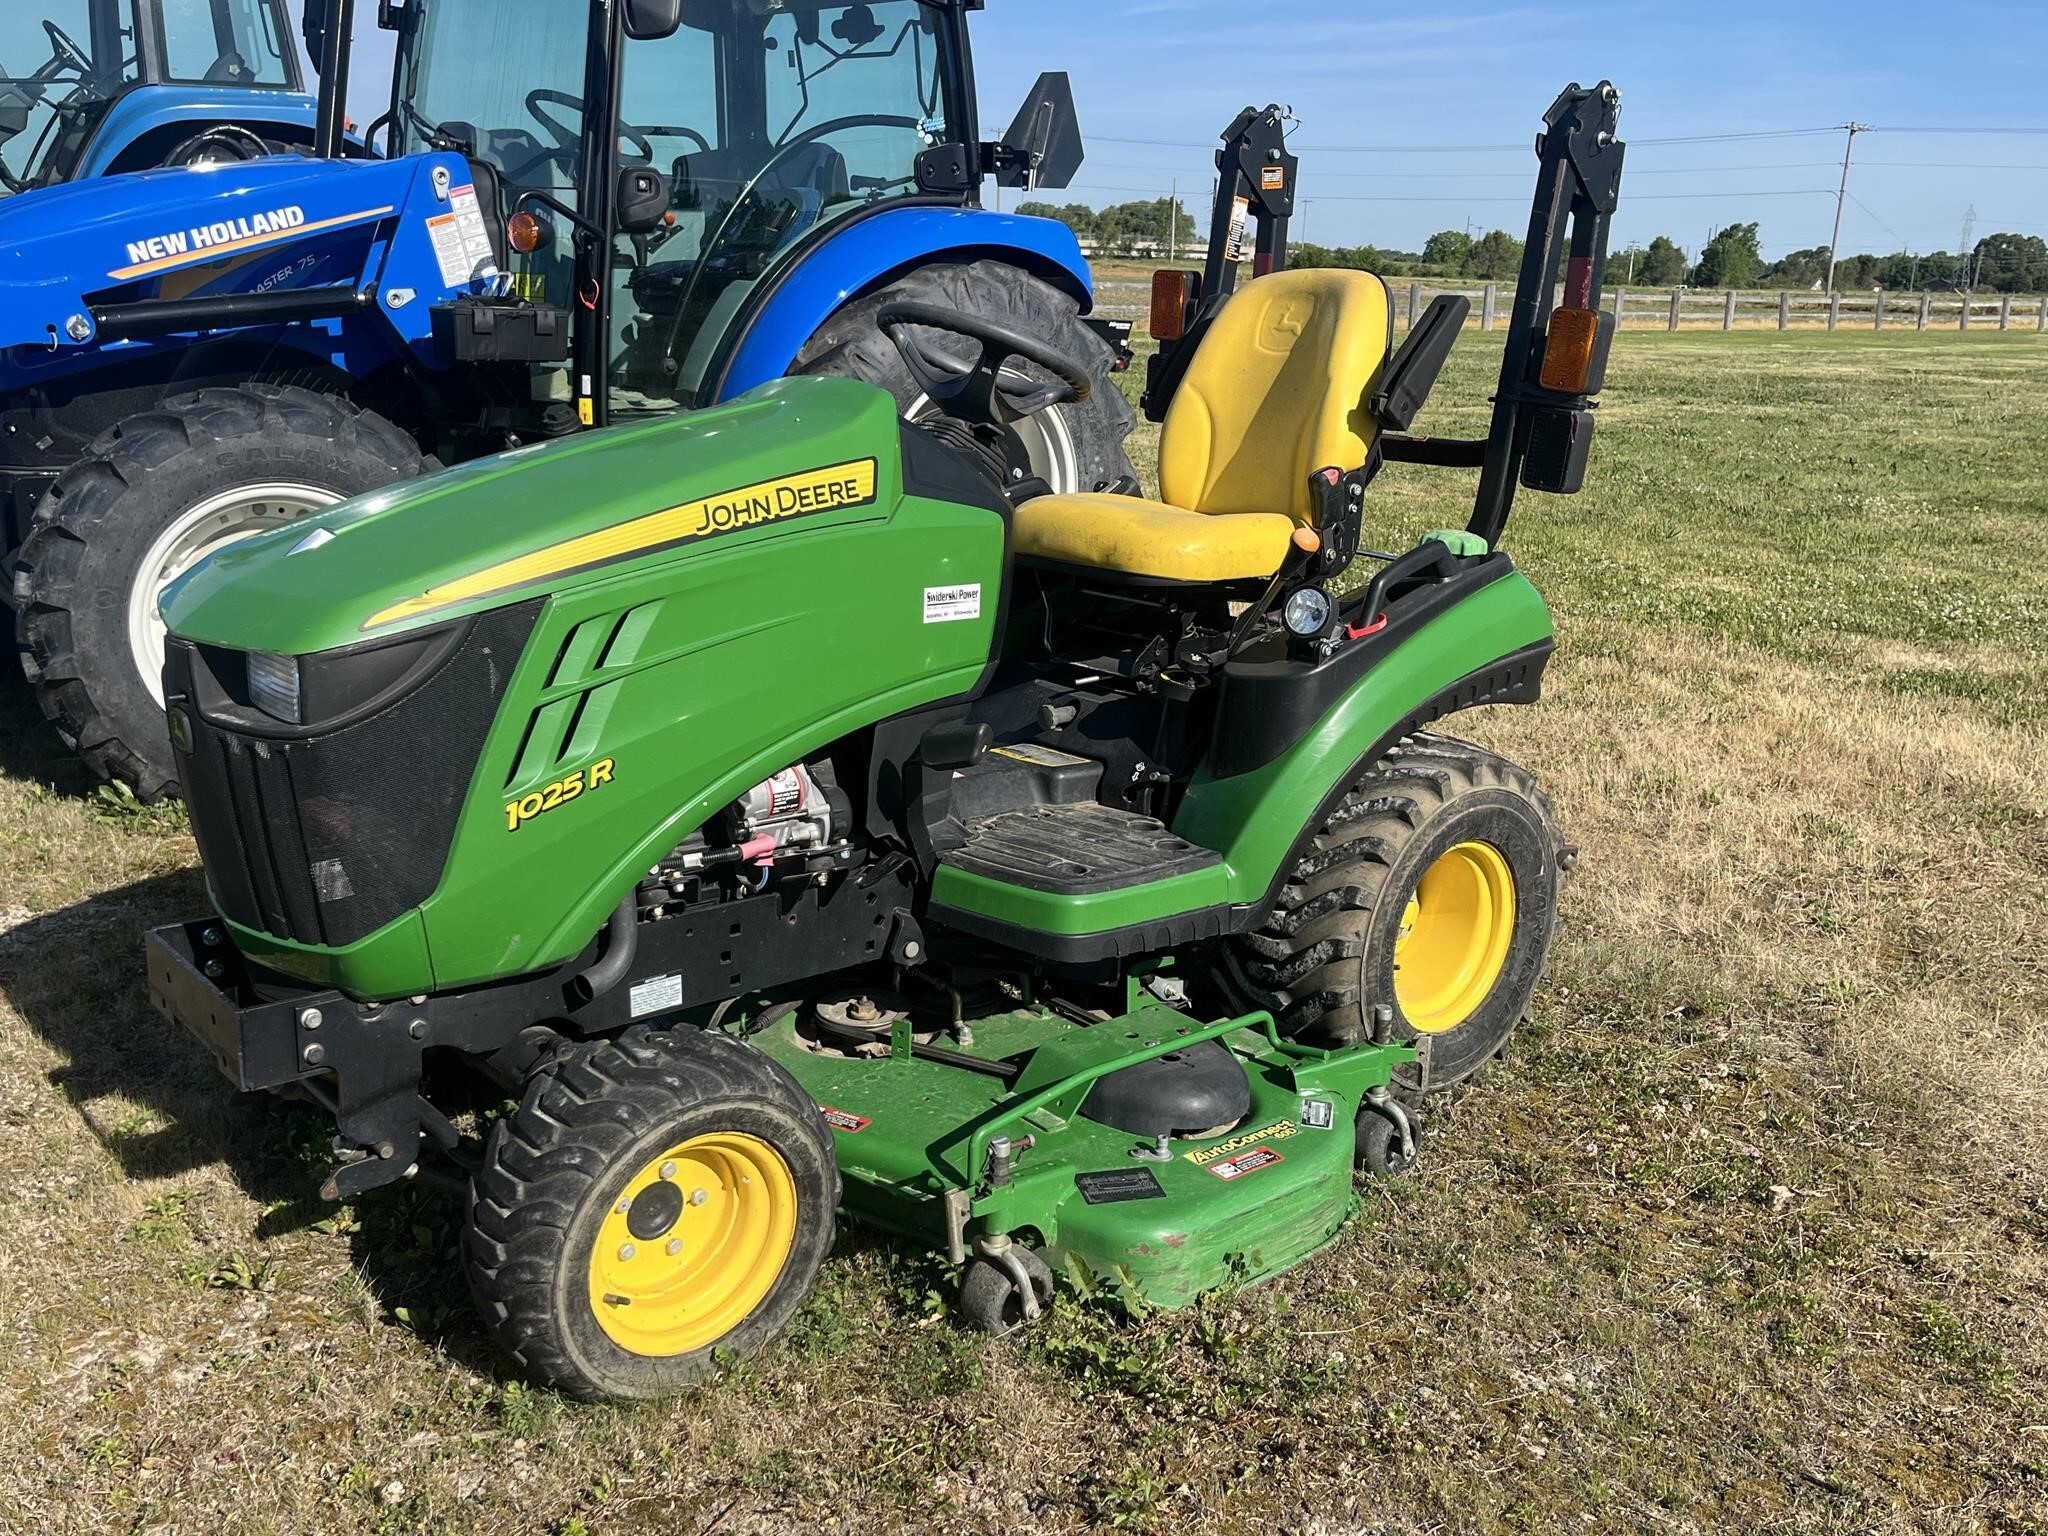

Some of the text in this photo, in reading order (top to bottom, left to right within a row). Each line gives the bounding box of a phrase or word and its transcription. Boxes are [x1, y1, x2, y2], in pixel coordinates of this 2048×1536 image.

[126, 205, 305, 264] NEW HOLLAND
[297, 254, 317, 272] 75
[696, 478, 860, 532] JOHN DEERE
[926, 588, 979, 603] Swiderski Power
[504, 757, 616, 832] 1025 R
[1193, 1118, 1296, 1164] AutoConnect
[1272, 1126, 1299, 1140] 60D
